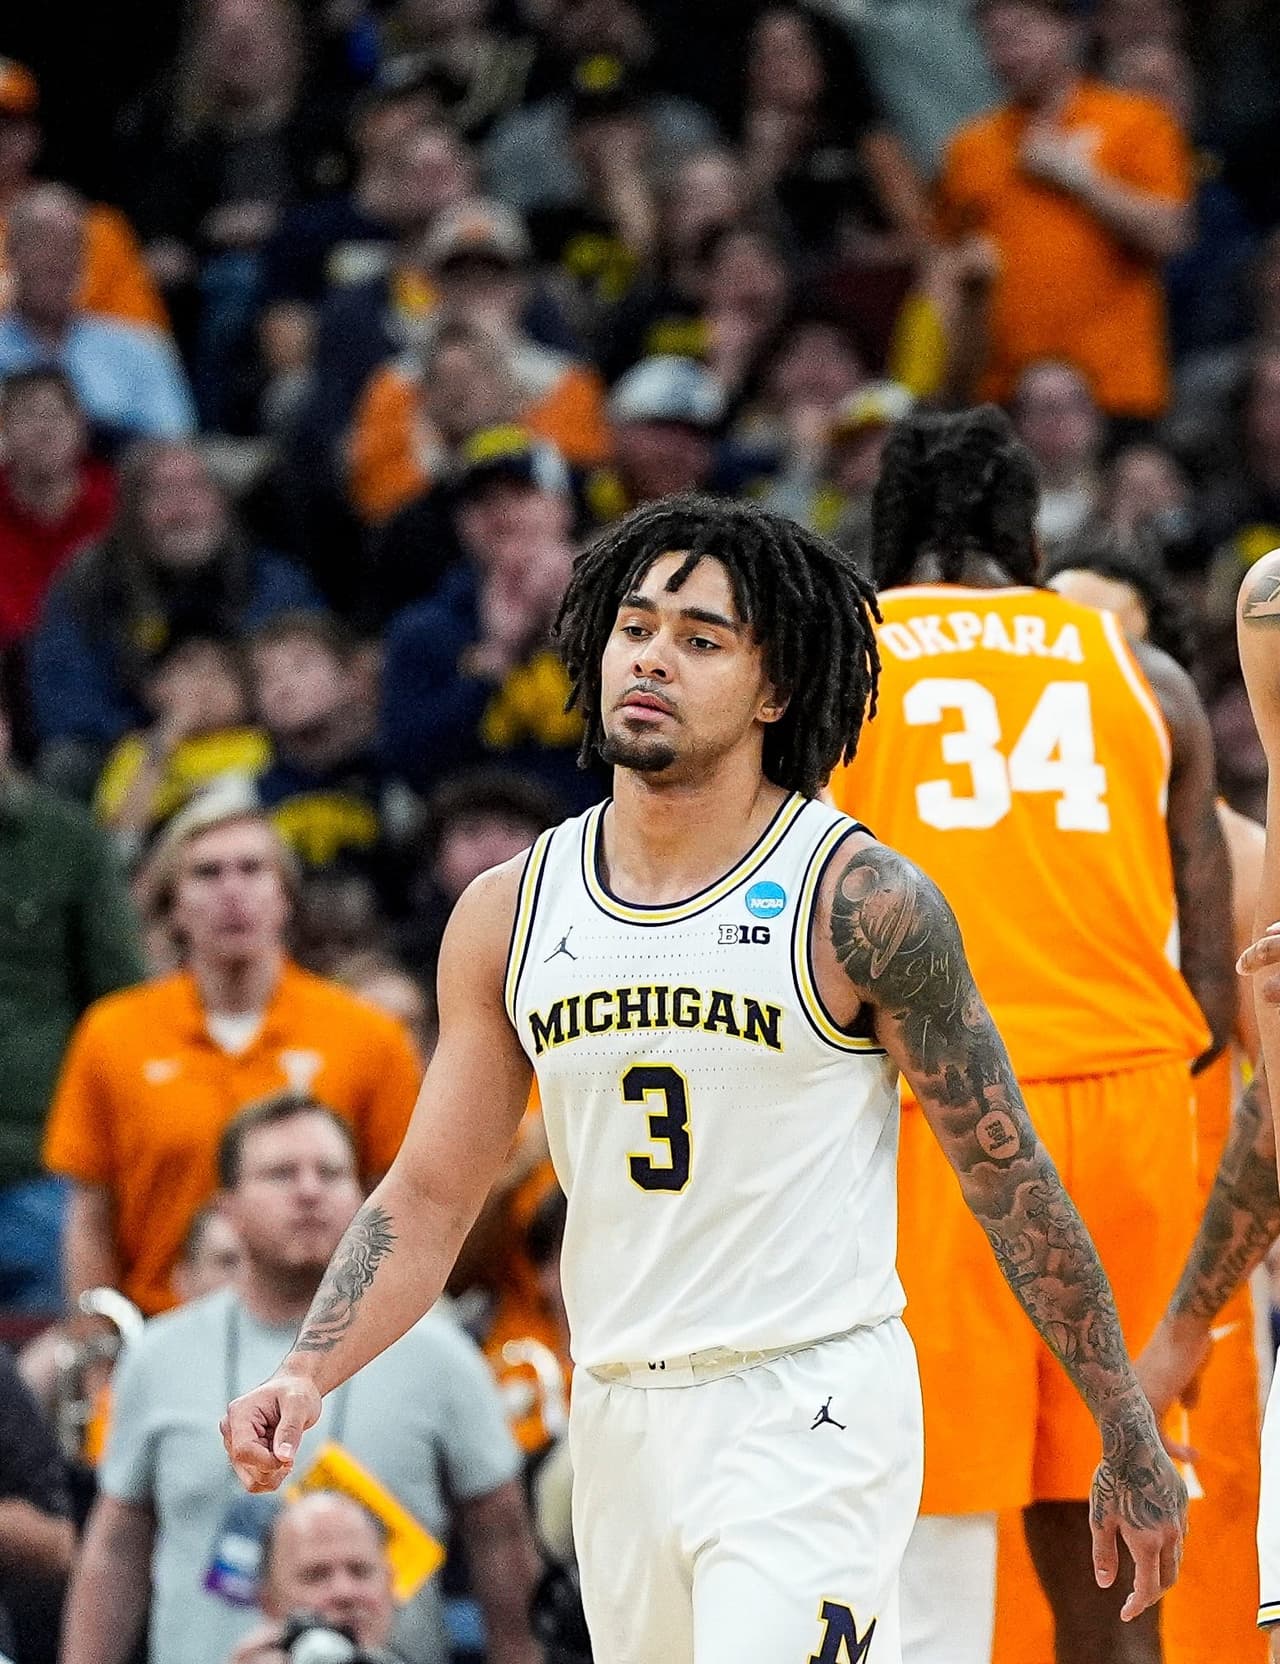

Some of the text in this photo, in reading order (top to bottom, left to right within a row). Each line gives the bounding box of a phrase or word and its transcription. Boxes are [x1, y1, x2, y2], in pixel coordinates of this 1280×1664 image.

[878, 611, 1085, 664] OKPARA
[903, 678, 1110, 833] 34
[528, 985, 784, 1057] MICHIGAN
[620, 1062, 694, 1195] 3
